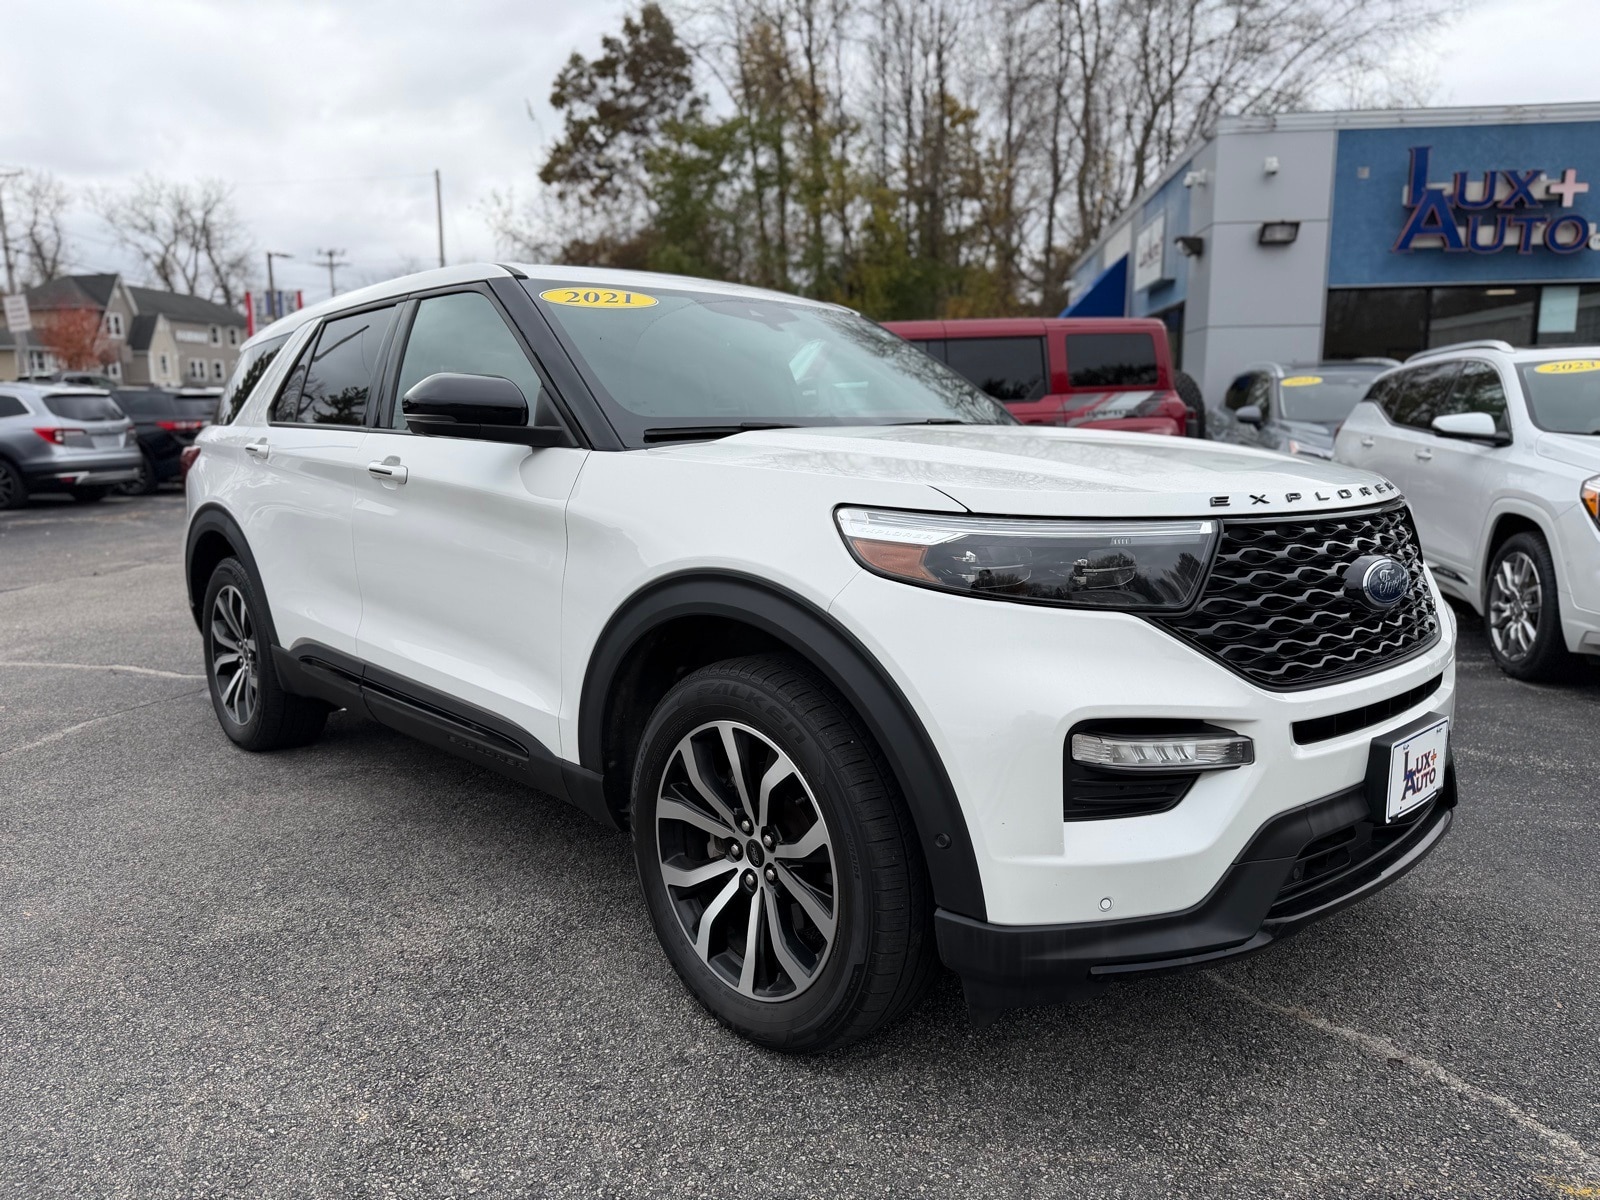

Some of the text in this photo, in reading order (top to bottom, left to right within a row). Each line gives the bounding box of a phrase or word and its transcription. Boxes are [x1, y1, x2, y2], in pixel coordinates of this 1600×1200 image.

[1391, 189, 1590, 254] AUTO
[564, 291, 635, 304] 2021
[1209, 481, 1395, 507] EXPLORER
[696, 682, 807, 745] FALKEN
[1400, 767, 1436, 801] AUTO
